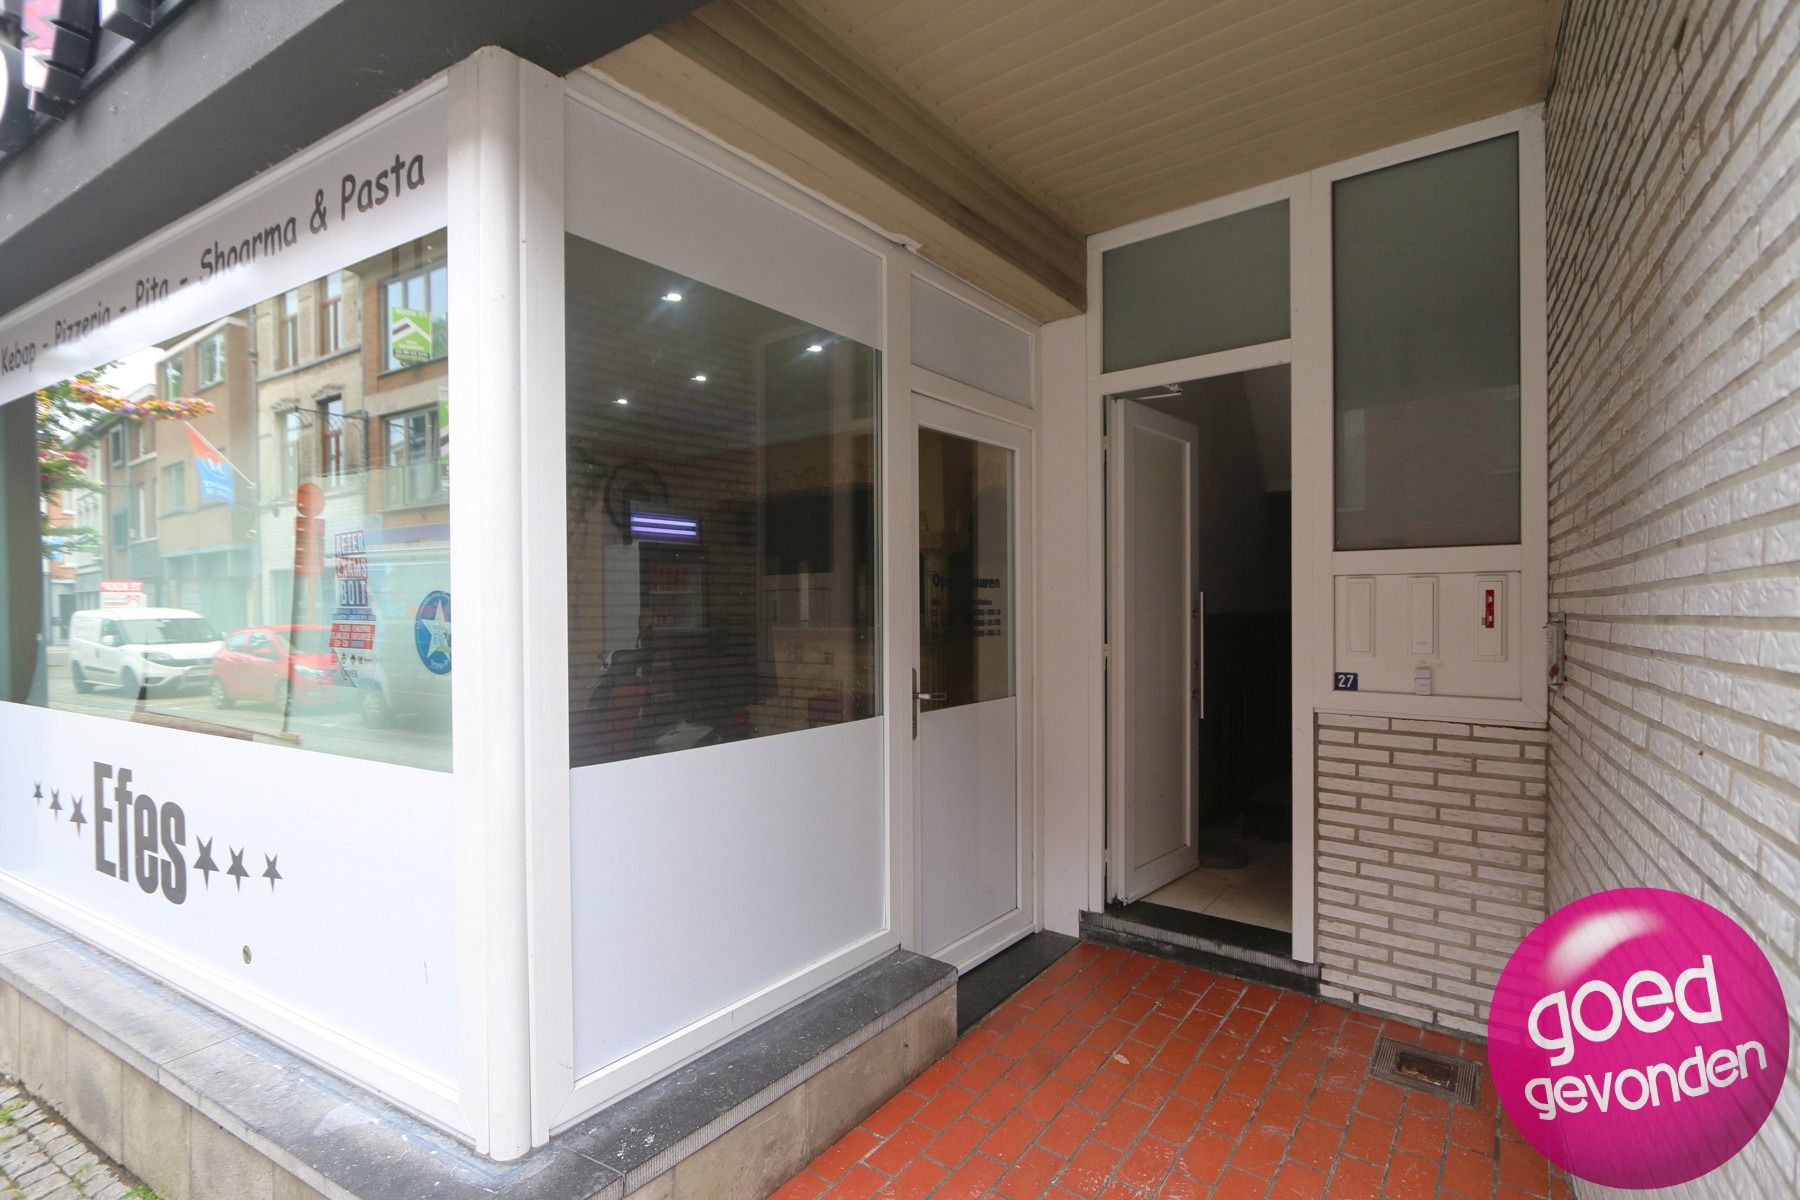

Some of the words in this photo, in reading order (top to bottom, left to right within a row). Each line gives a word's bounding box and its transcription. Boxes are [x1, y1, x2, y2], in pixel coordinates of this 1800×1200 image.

[1, 341, 36, 376] Kebap
[55, 302, 111, 347] Pizzeria
[136, 277, 169, 309] Pita
[200, 216, 297, 278] Shoarma
[309, 189, 328, 235] &
[341, 153, 425, 221] Pasta
[1337, 674, 1354, 688] 27
[93, 761, 187, 905] Efes
